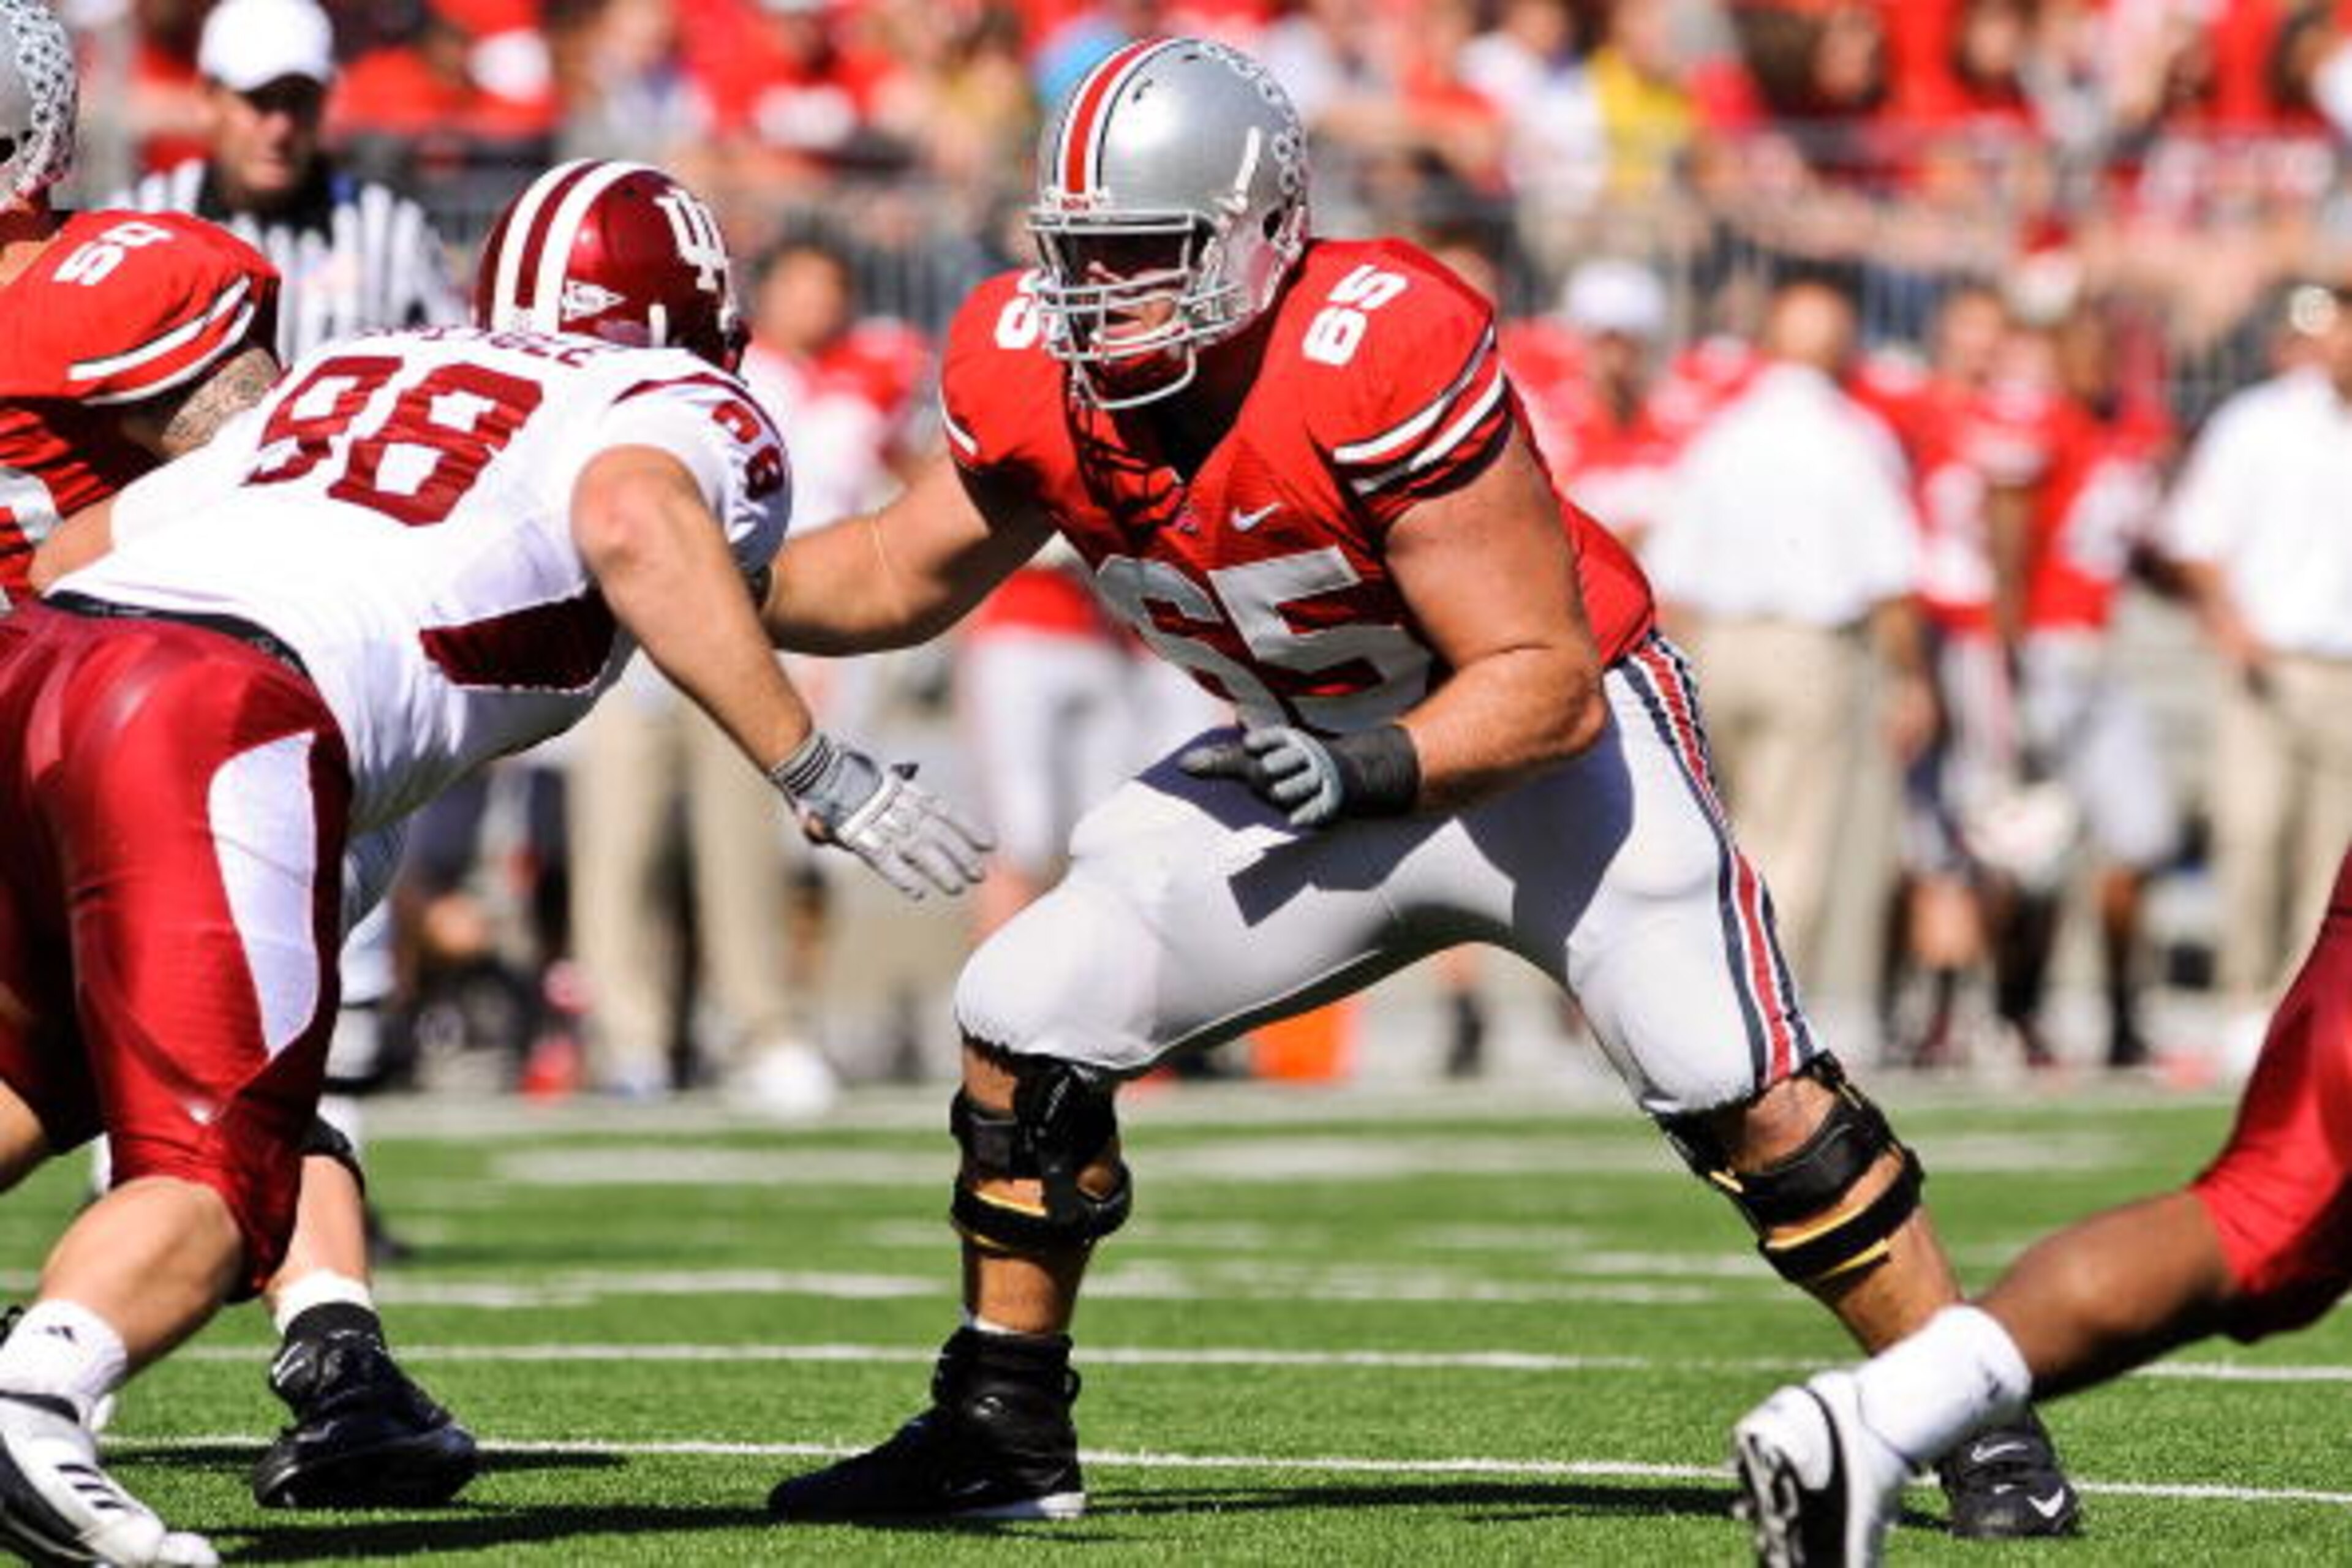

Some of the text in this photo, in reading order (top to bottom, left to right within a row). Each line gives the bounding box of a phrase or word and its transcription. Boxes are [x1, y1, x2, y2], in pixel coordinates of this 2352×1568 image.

[1302, 263, 1409, 366] 65
[239, 355, 544, 527] 98
[1095, 545, 1431, 735] 65
